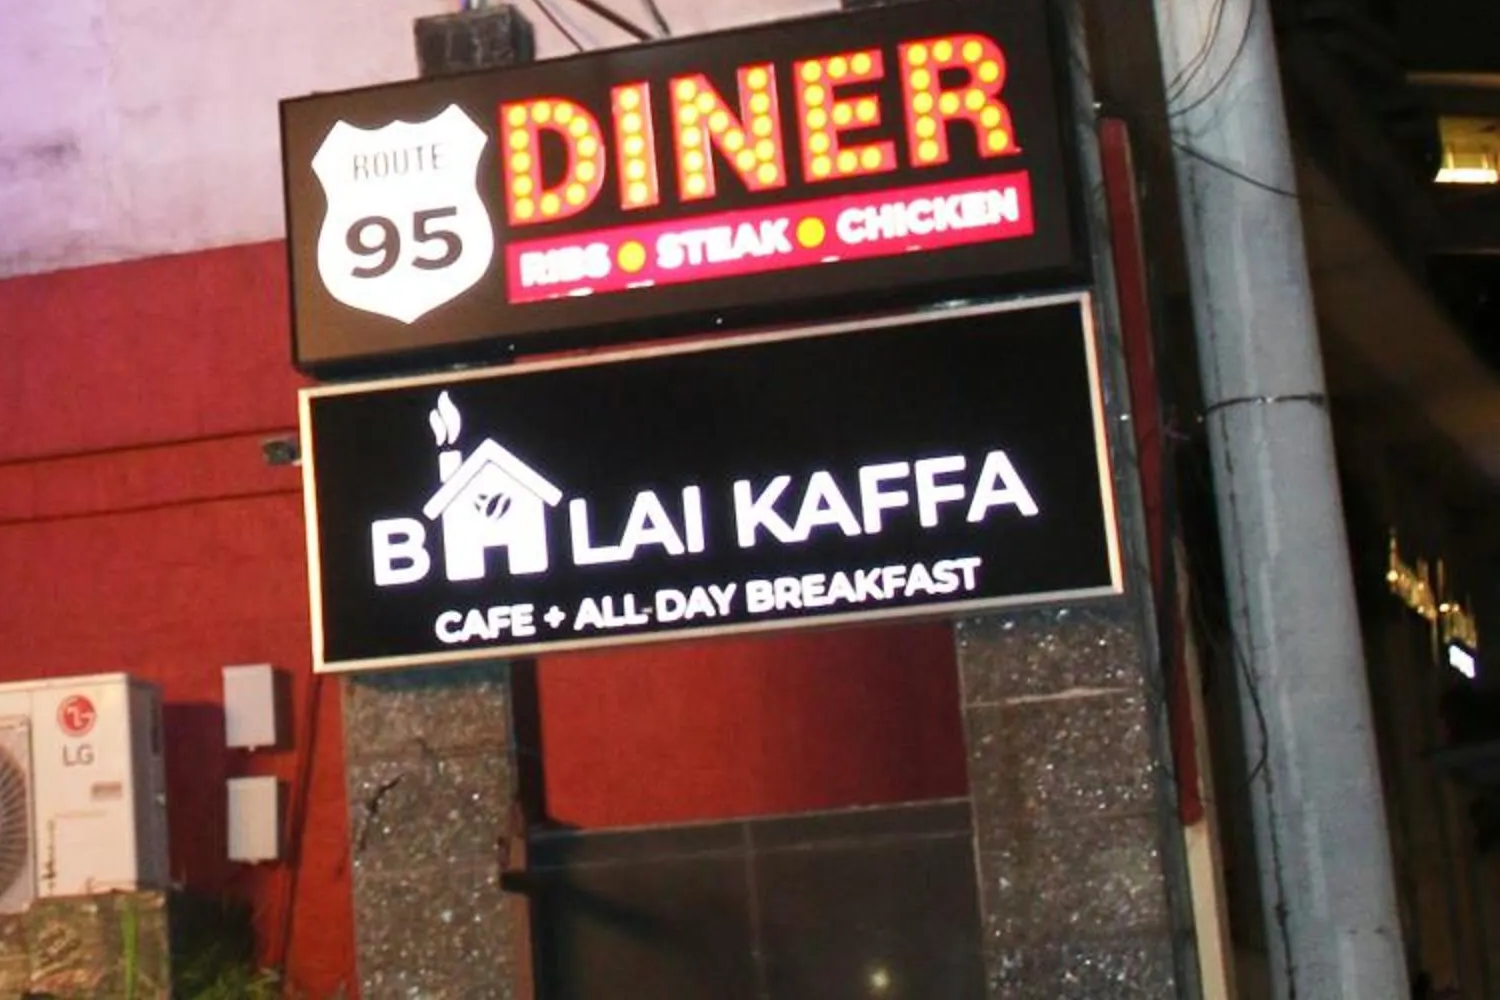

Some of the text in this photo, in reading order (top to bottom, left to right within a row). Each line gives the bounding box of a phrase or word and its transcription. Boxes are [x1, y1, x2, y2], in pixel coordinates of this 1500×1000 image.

[352, 142, 446, 182] ROUTE
[501, 31, 1022, 226] DINER
[345, 206, 463, 279] 95
[519, 187, 1019, 288] RIBS STEAK CHICKEN
[733, 450, 1039, 548] KAFFA
[435, 604, 536, 643] CAFE
[574, 582, 737, 631] ALL-DAY
[745, 556, 982, 613] BREAKFAST
[62, 743, 95, 767] LG
